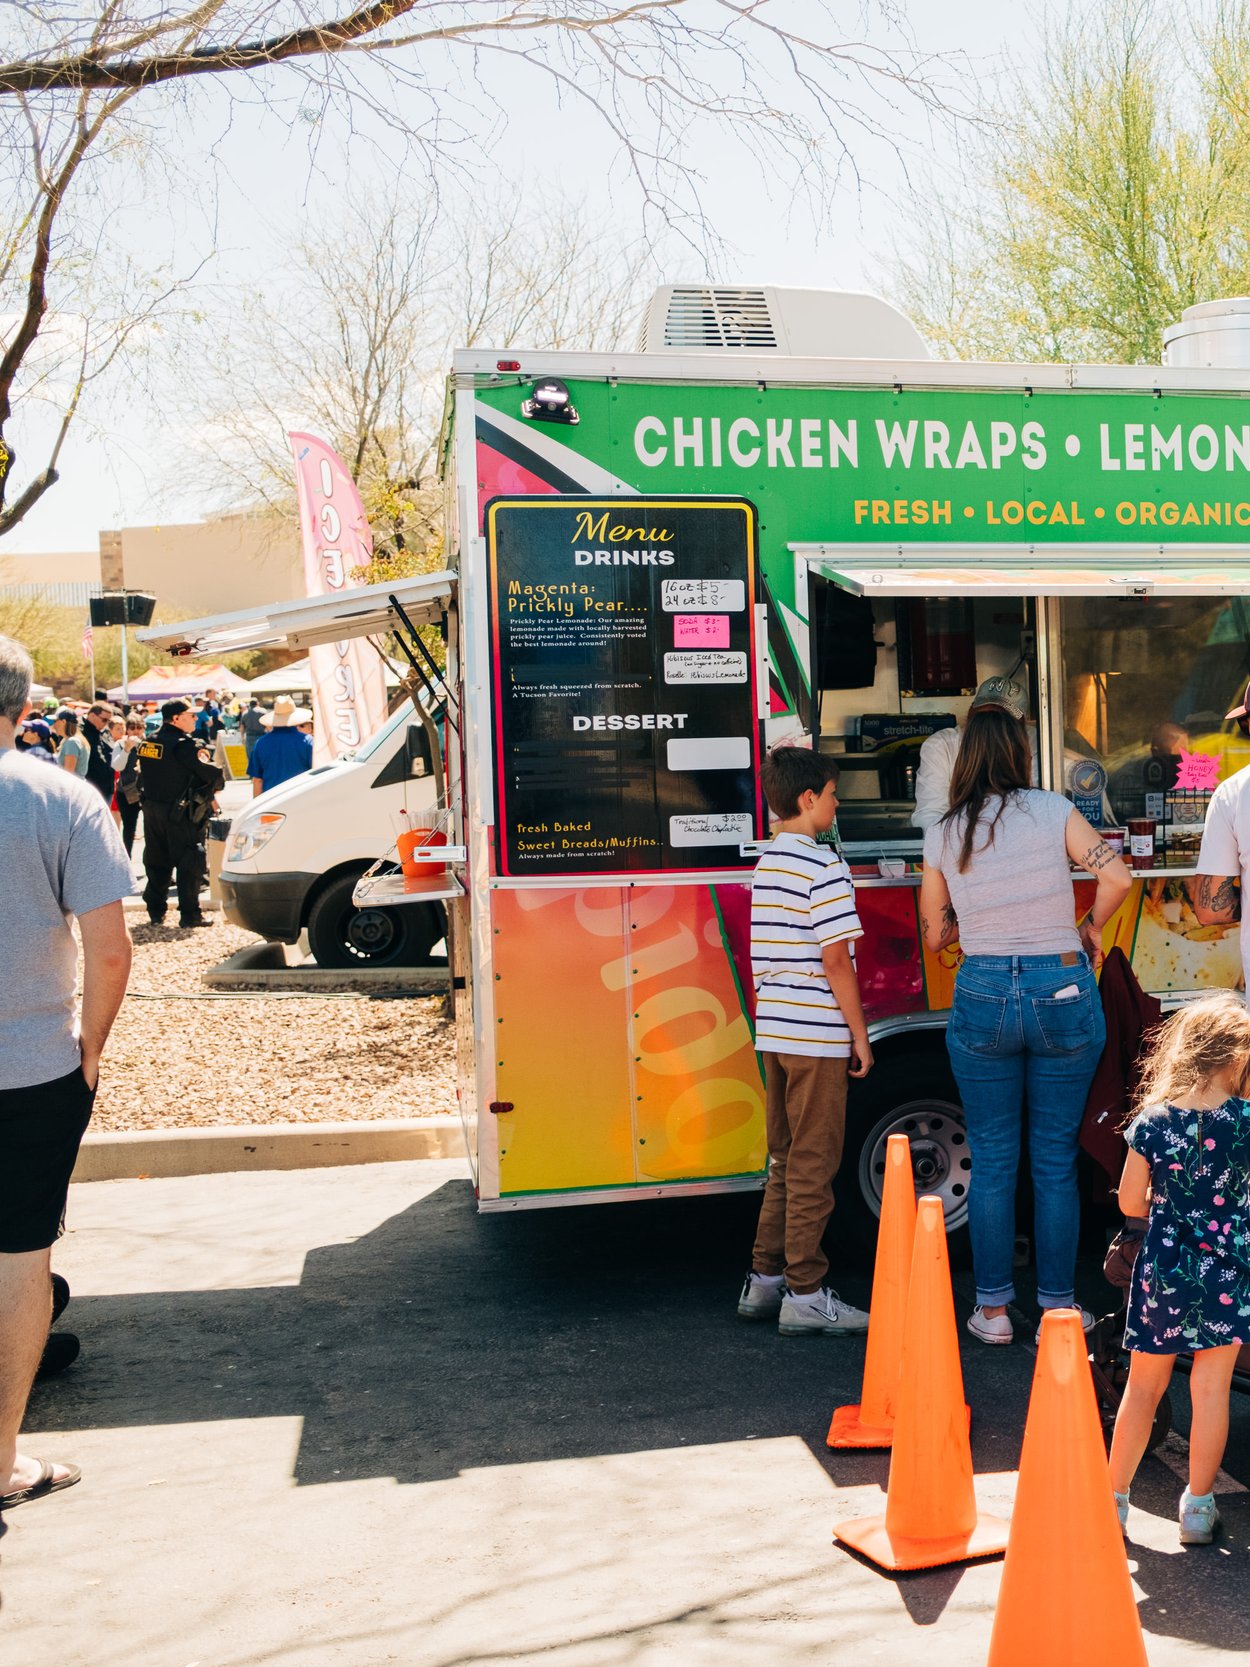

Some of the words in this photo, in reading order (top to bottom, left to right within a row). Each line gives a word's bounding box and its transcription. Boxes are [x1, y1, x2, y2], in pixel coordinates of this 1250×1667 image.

[634, 416, 858, 468] CHICKEN
[875, 420, 1046, 470] WRAPS
[855, 500, 951, 524] FRESH
[987, 501, 1084, 524] LOCAL
[571, 512, 674, 544] Menu
[575, 550, 675, 566] DRINKS
[508, 581, 595, 602] Magenta:
[666, 581, 678, 593] 16
[665, 595, 679, 606] 24
[508, 598, 573, 616] Prickly
[510, 618, 535, 627] Prickly
[613, 618, 646, 626] amazing
[587, 625, 611, 633] locally
[573, 714, 688, 731] DESSERT
[884, 725, 934, 735] stretch-tite
[1188, 765, 1213, 774] HONEY
[517, 823, 548, 833] Fresh
[554, 822, 591, 832] Baked
[518, 840, 555, 850] Sweet
[519, 853, 544, 861] Always
